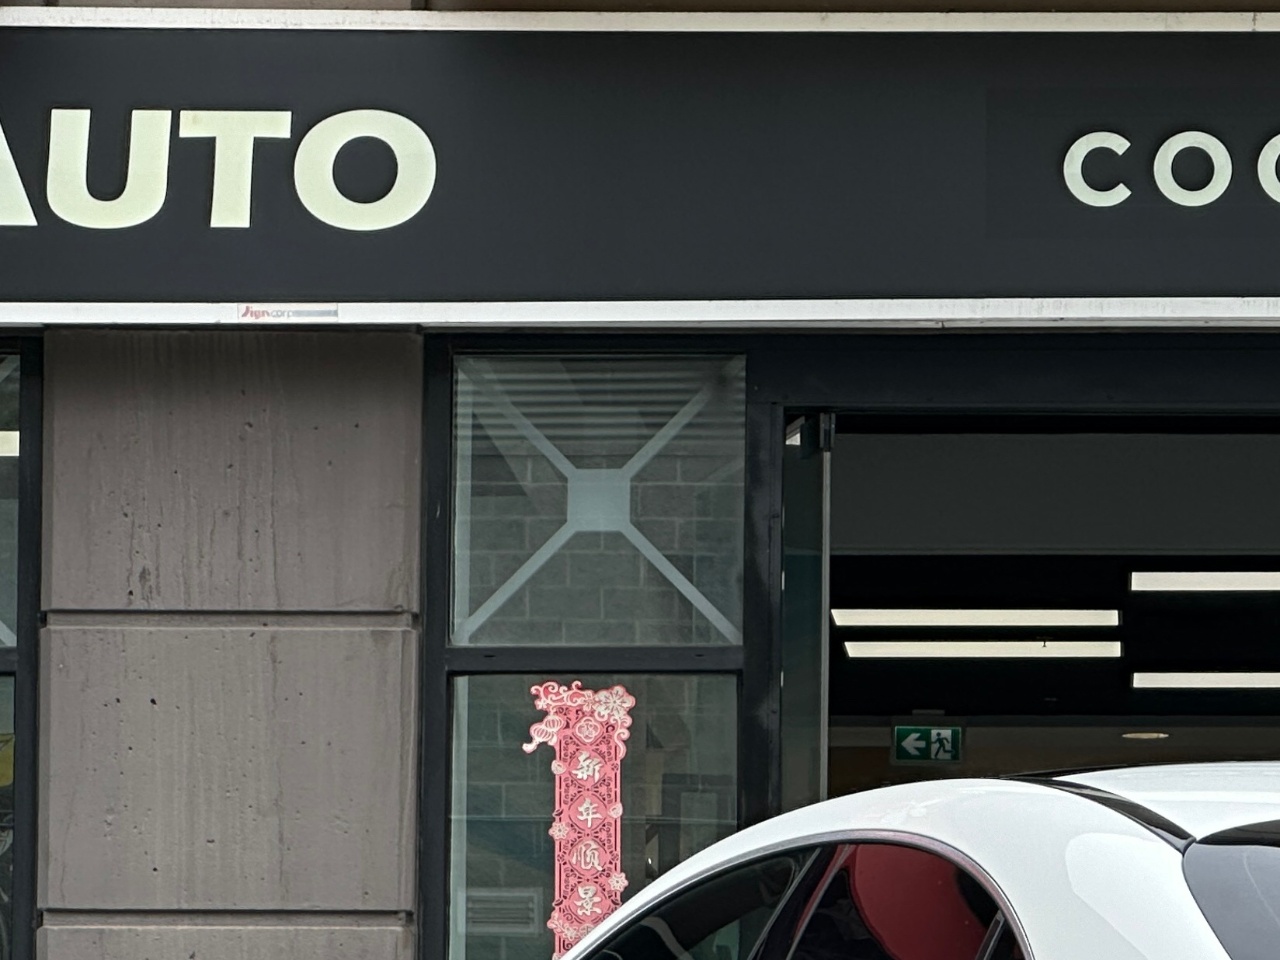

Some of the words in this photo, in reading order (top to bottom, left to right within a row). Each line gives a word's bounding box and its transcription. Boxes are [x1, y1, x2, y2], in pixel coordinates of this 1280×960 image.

[0, 108, 437, 231] UTO
[570, 751, 604, 917] 新年顺景
